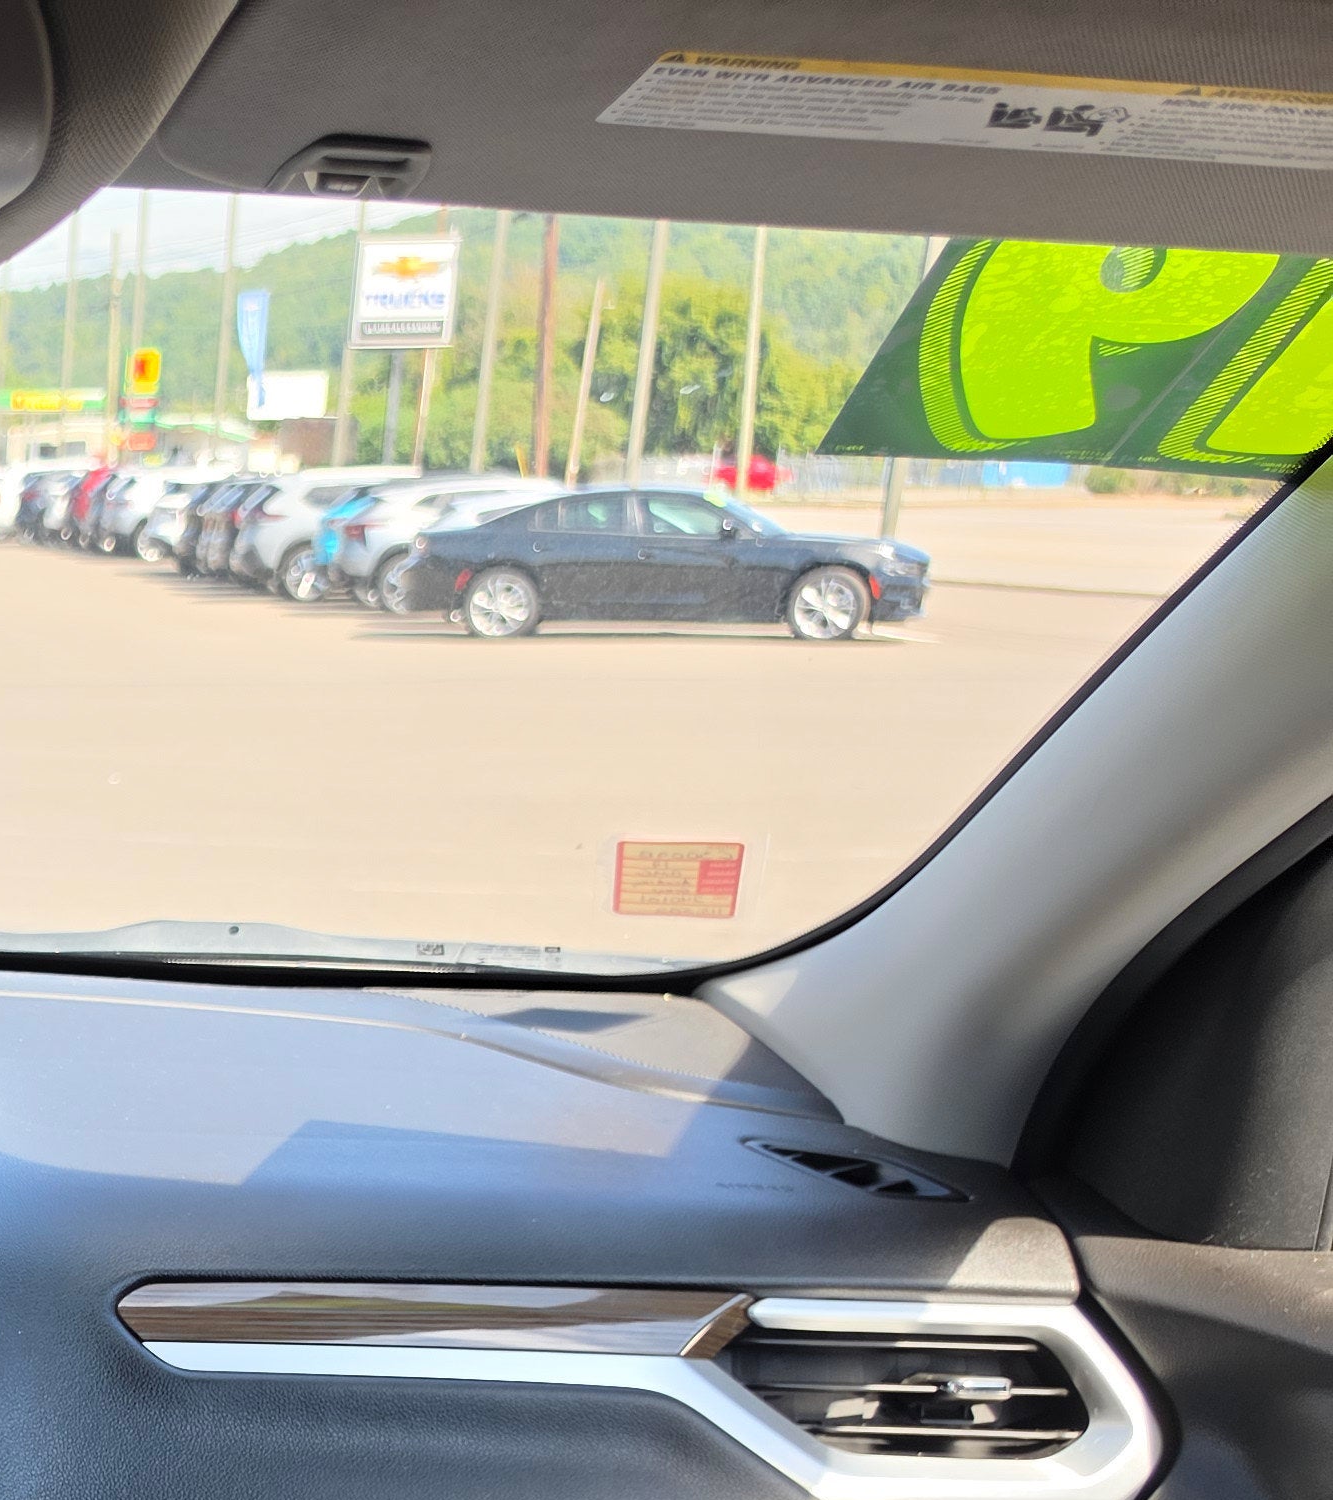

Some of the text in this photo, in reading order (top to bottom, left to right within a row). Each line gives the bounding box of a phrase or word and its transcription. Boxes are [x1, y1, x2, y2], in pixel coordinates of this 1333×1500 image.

[694, 55, 803, 70] WARNING
[652, 66, 710, 78] EVEN
[714, 71, 770, 83] WITH
[772, 75, 893, 88] ADVANCED
[896, 81, 936, 90] AIR
[939, 84, 1002, 95] BAGS
